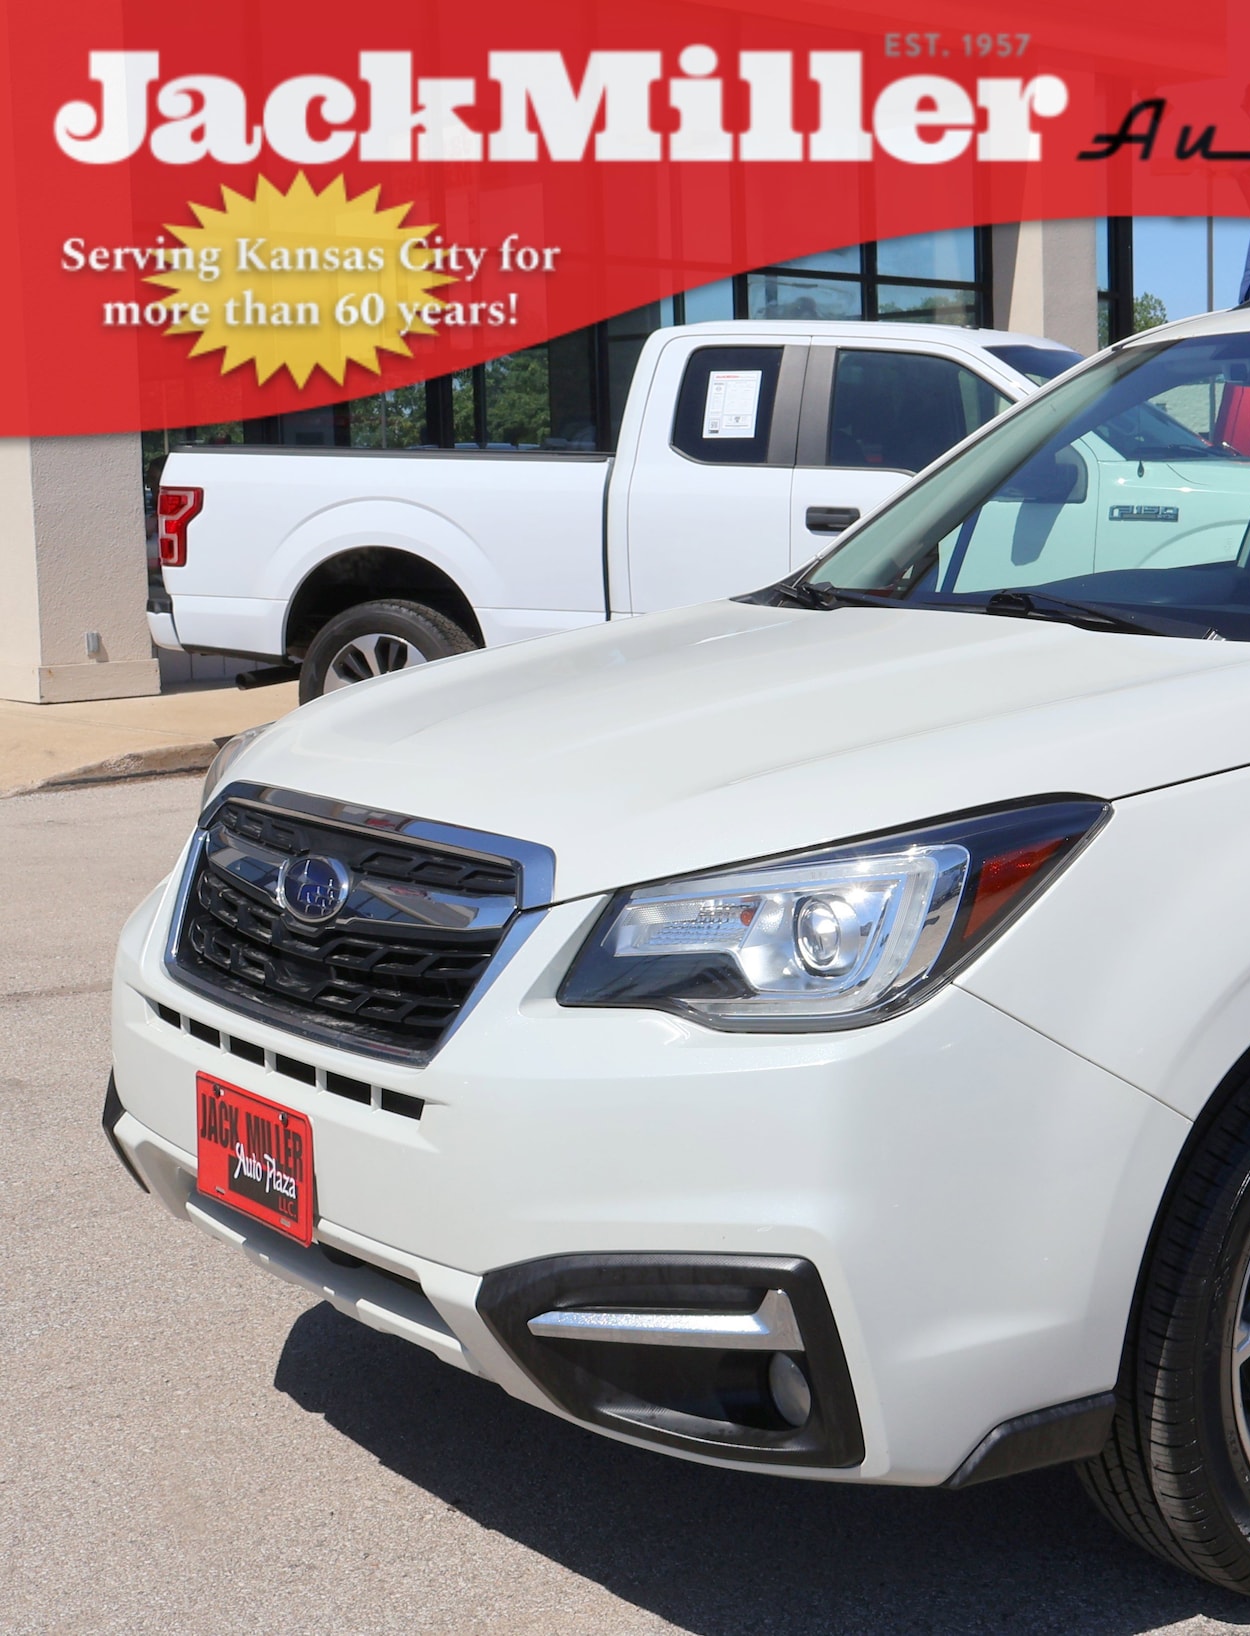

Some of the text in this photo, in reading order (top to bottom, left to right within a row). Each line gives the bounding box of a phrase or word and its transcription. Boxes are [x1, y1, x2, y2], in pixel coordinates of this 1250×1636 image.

[200, 1092, 304, 1183] JACK MILLER
[233, 1142, 297, 1199] Auto Plaza
